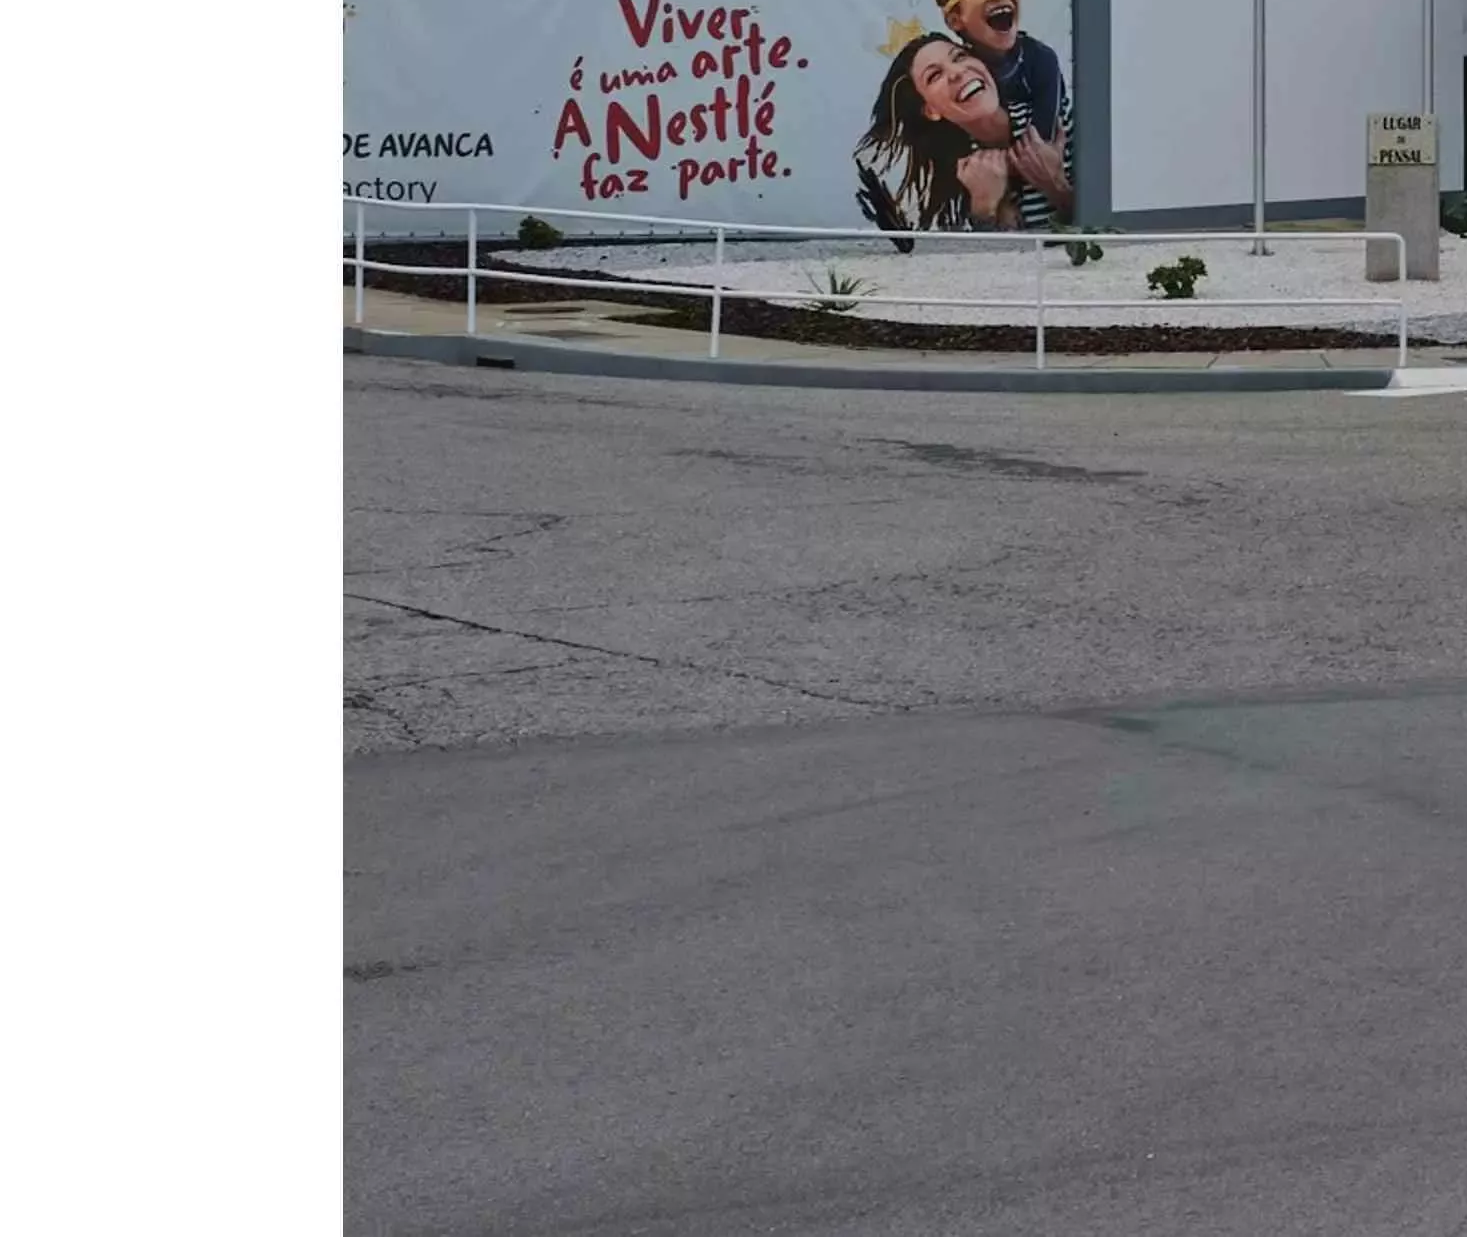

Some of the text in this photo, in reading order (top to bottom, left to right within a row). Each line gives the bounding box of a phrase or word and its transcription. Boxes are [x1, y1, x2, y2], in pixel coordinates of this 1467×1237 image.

[569, 22, 809, 94] é uma arte.
[378, 132, 495, 159] AVANCA
[554, 73, 776, 165] A Nestlé
[580, 135, 791, 201] faz parte.
